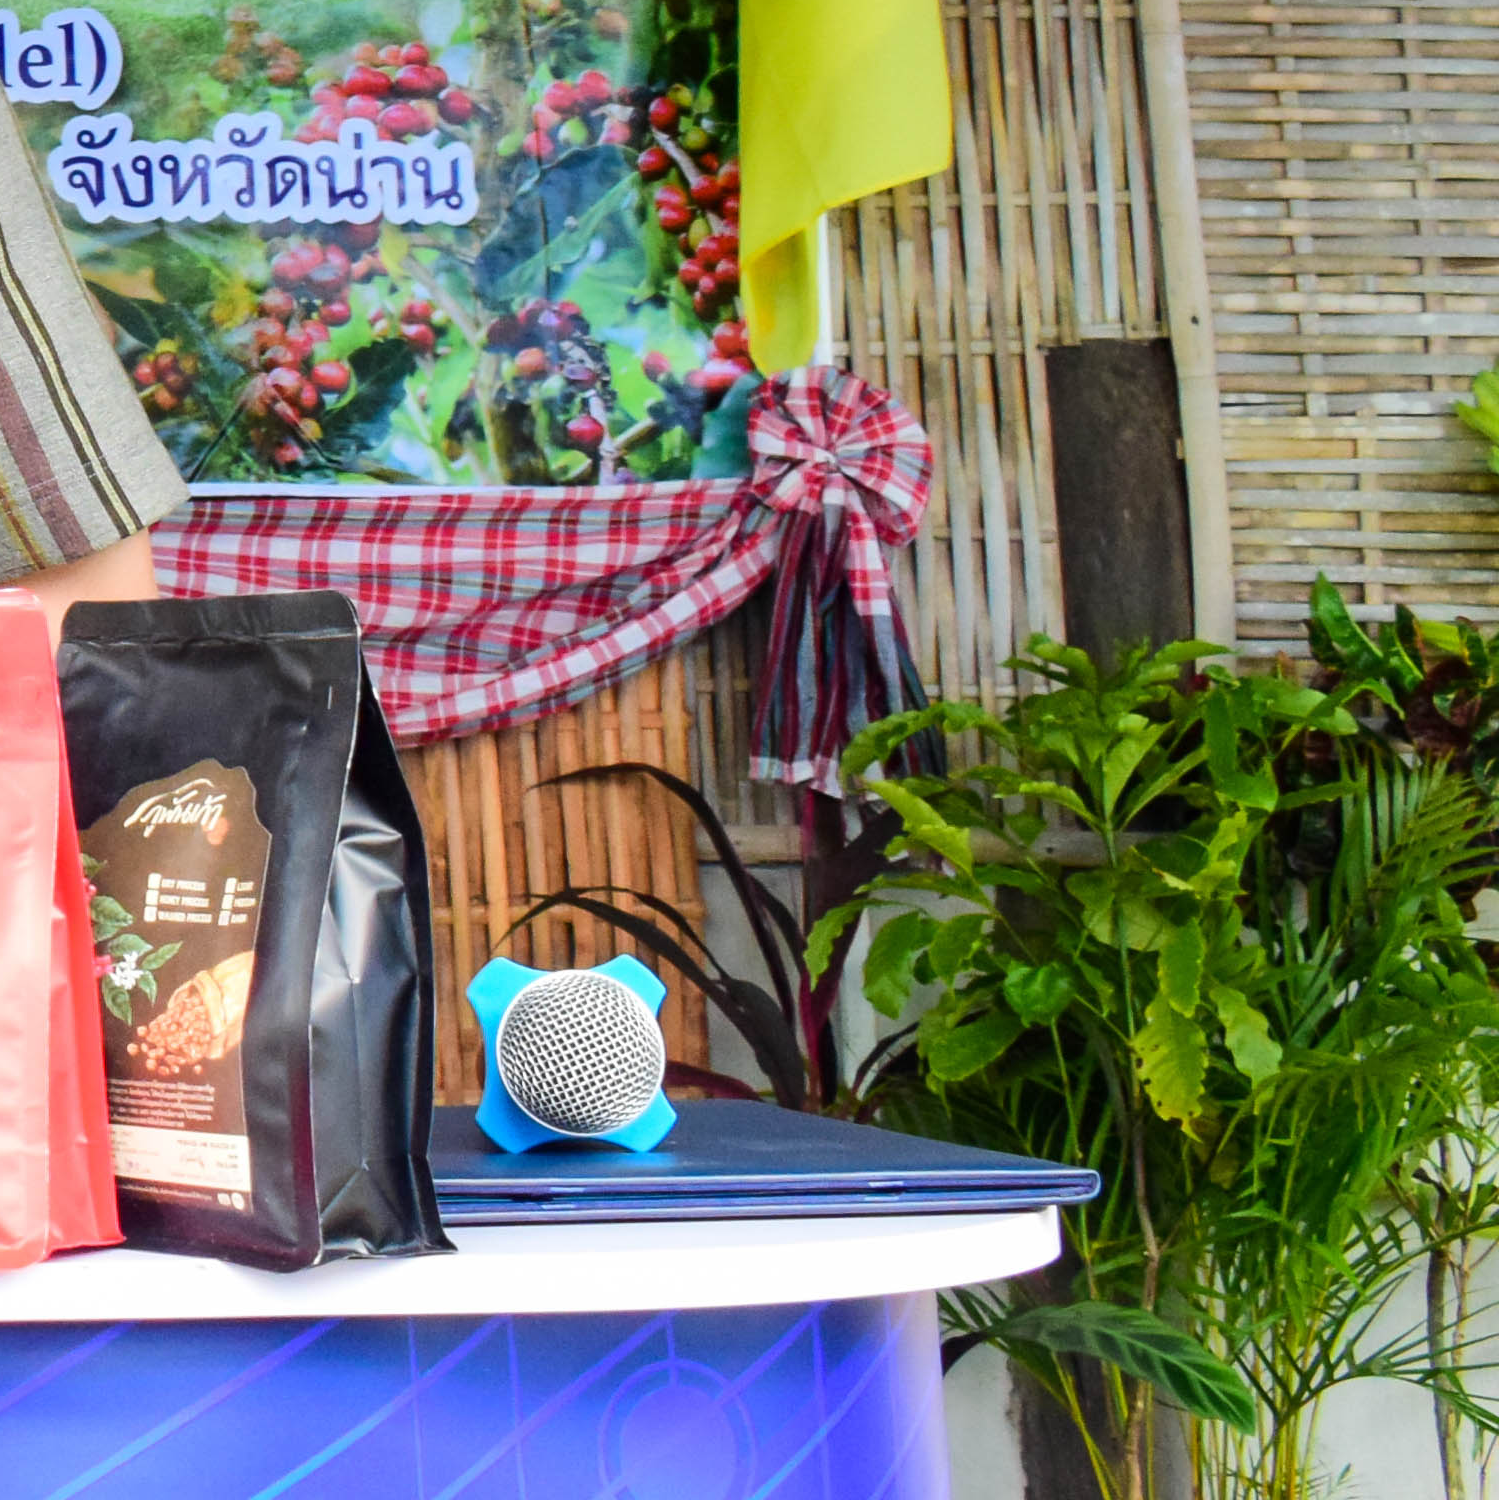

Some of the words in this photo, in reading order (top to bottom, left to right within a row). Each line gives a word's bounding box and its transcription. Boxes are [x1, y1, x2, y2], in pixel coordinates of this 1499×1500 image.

[62, 126, 463, 209] จังหวัดน่าน
